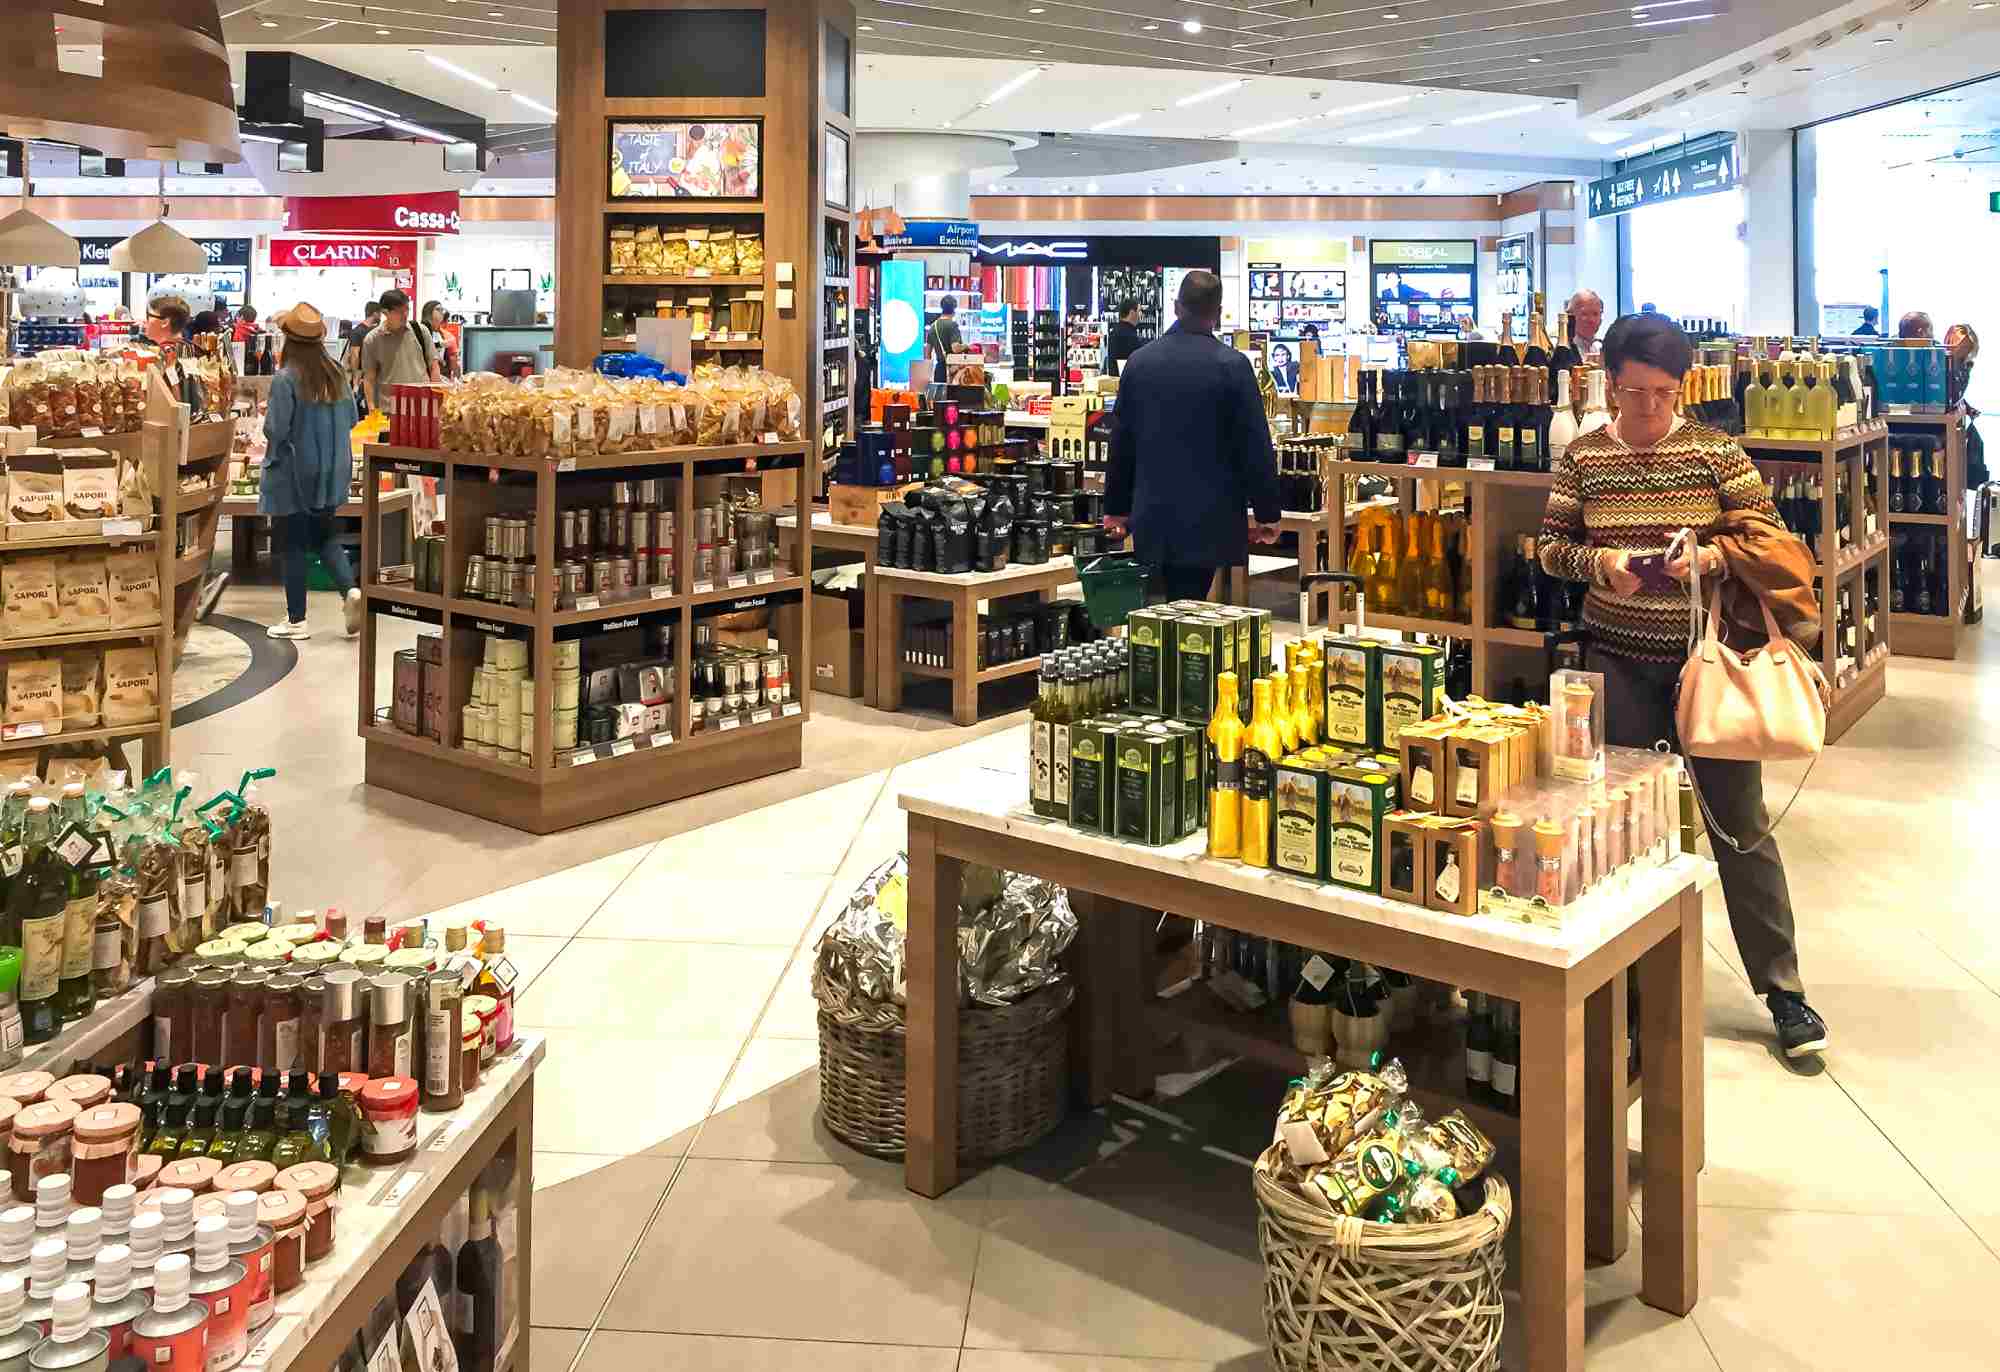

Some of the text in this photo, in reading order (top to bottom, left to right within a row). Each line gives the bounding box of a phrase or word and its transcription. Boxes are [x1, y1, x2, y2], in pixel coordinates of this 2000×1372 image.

[629, 134, 662, 146] TASTE
[629, 161, 660, 174] ITALY
[19, 494, 54, 502] SAPORI
[73, 492, 107, 500] SAPORI
[14, 591, 49, 600] SAPORI
[116, 679, 149, 689] SAPORI
[17, 689, 52, 700] SAPORI
